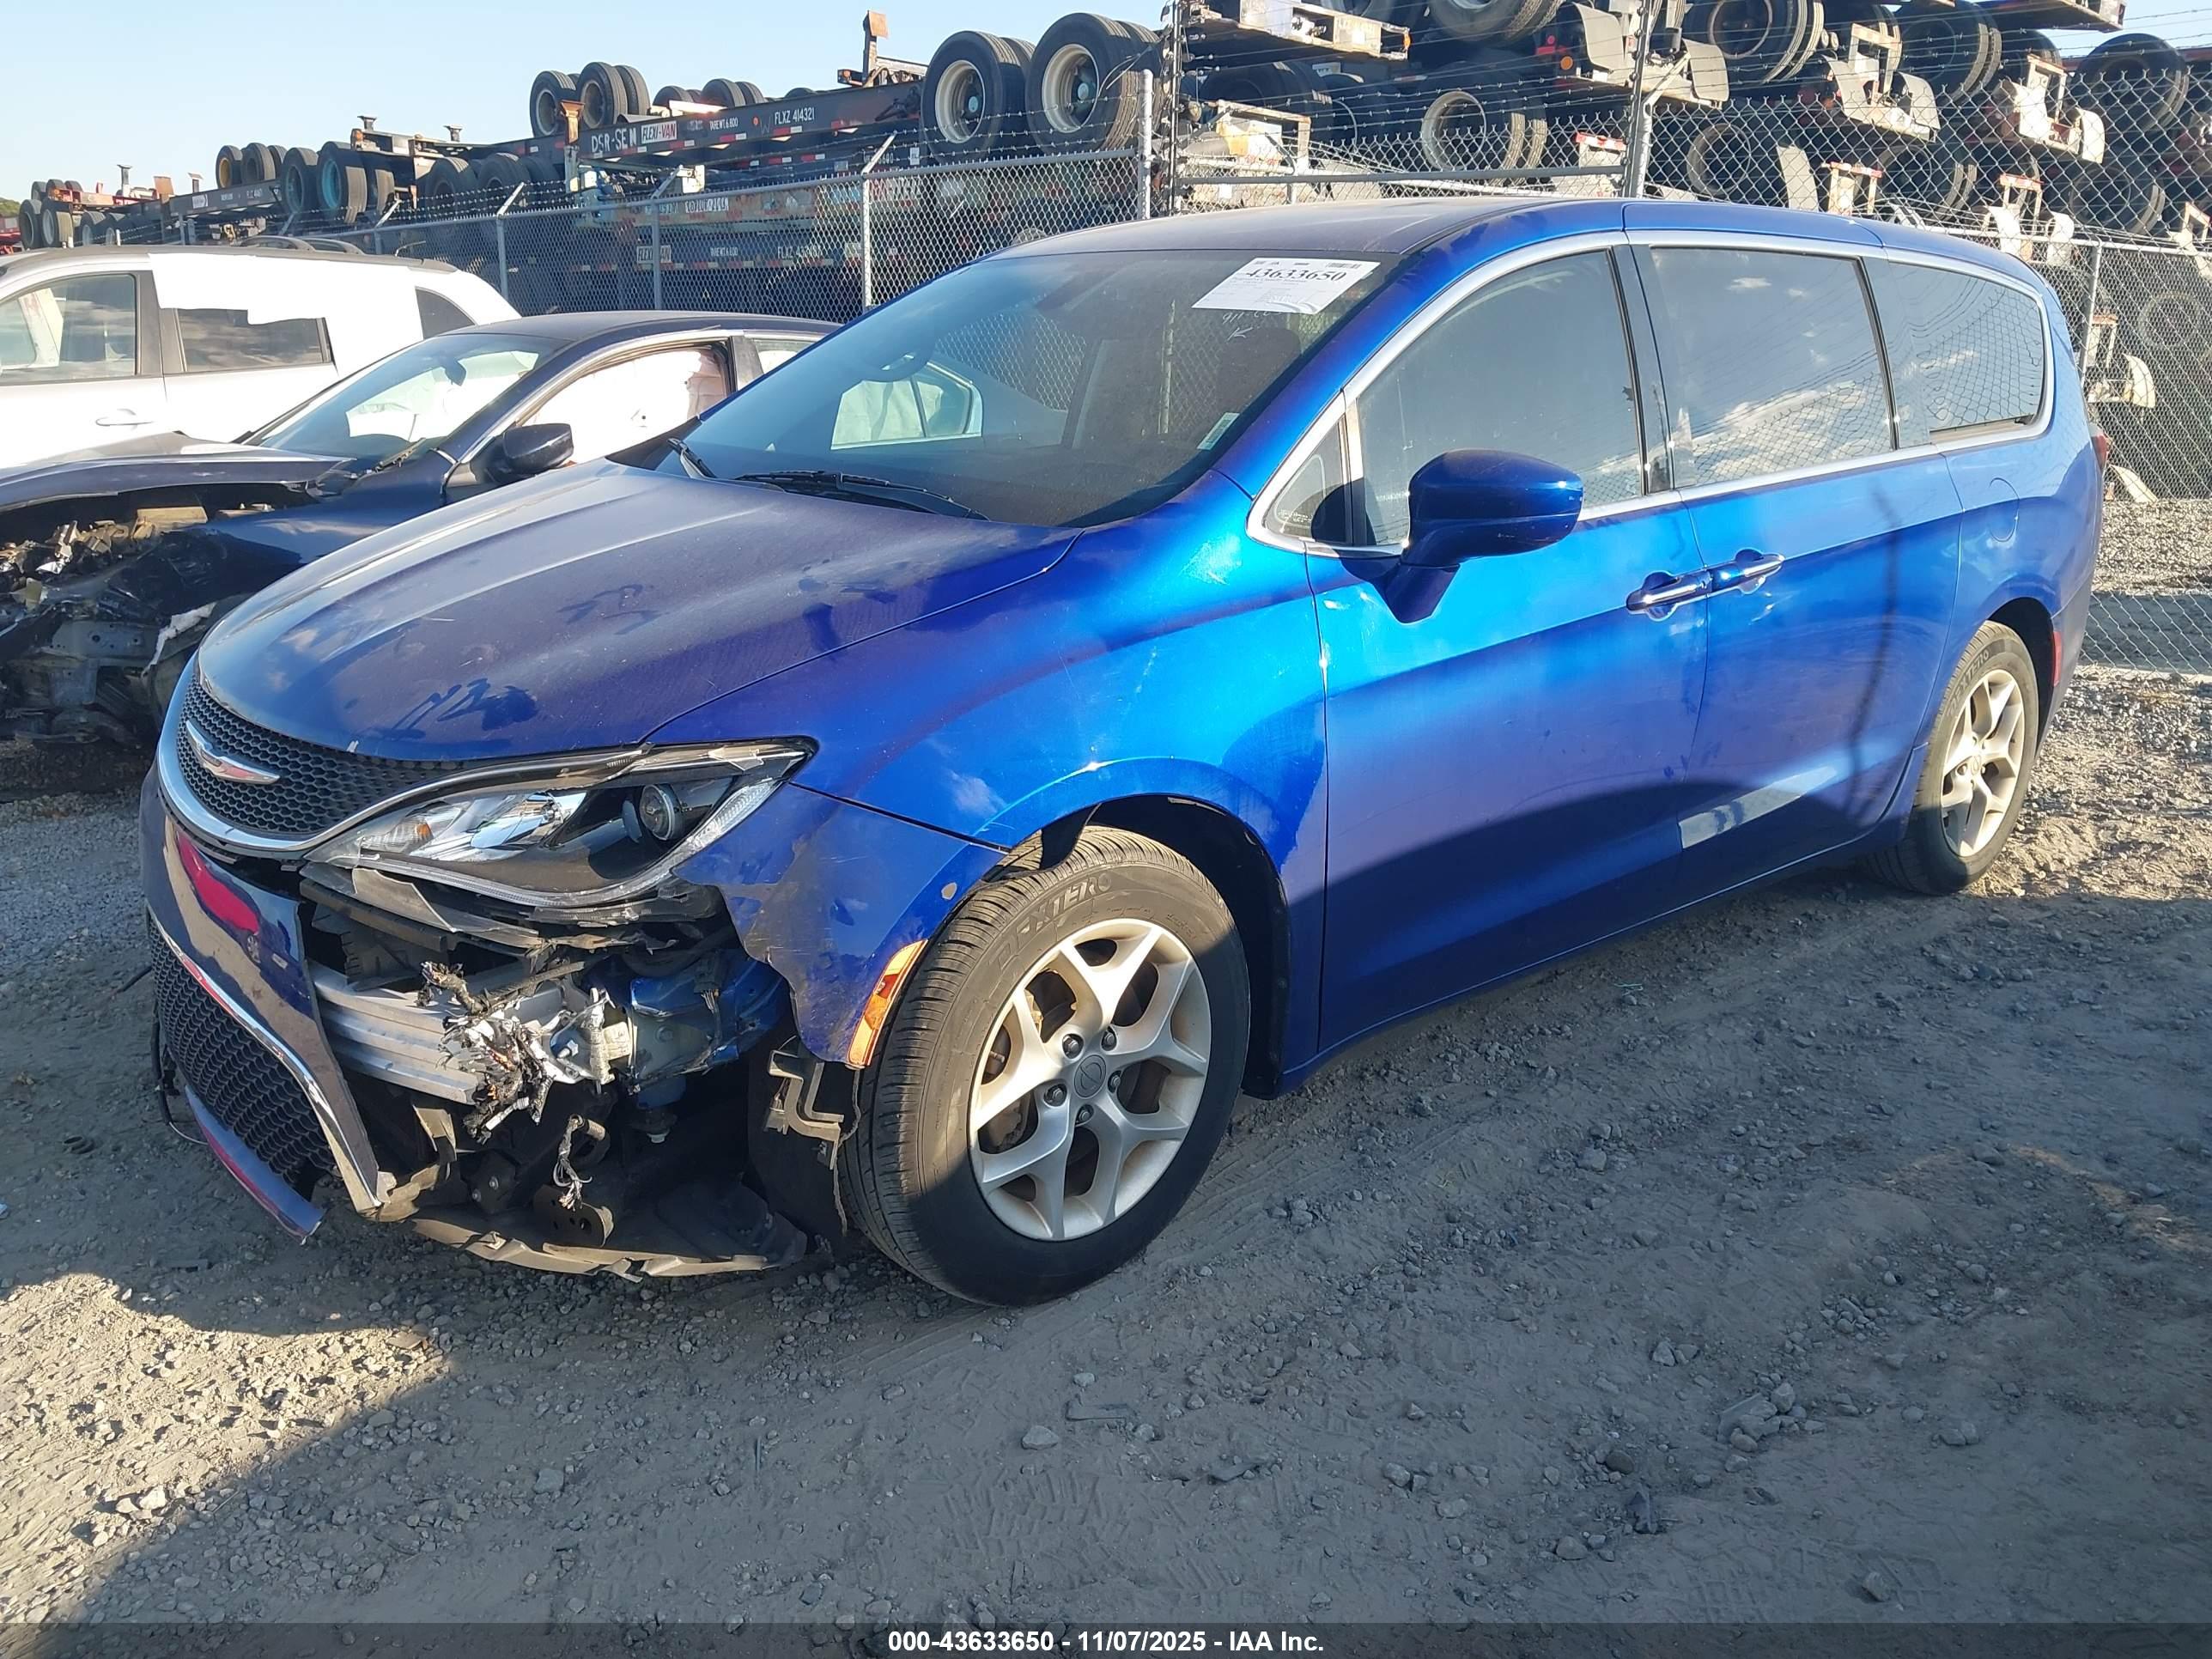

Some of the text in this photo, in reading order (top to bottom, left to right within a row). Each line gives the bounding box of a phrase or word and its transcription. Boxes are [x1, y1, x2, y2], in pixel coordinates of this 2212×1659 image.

[775, 106, 815, 125] FLXZ 414321
[642, 122, 677, 142] FLEXI-VAN
[1246, 268, 1346, 282] 43633650
